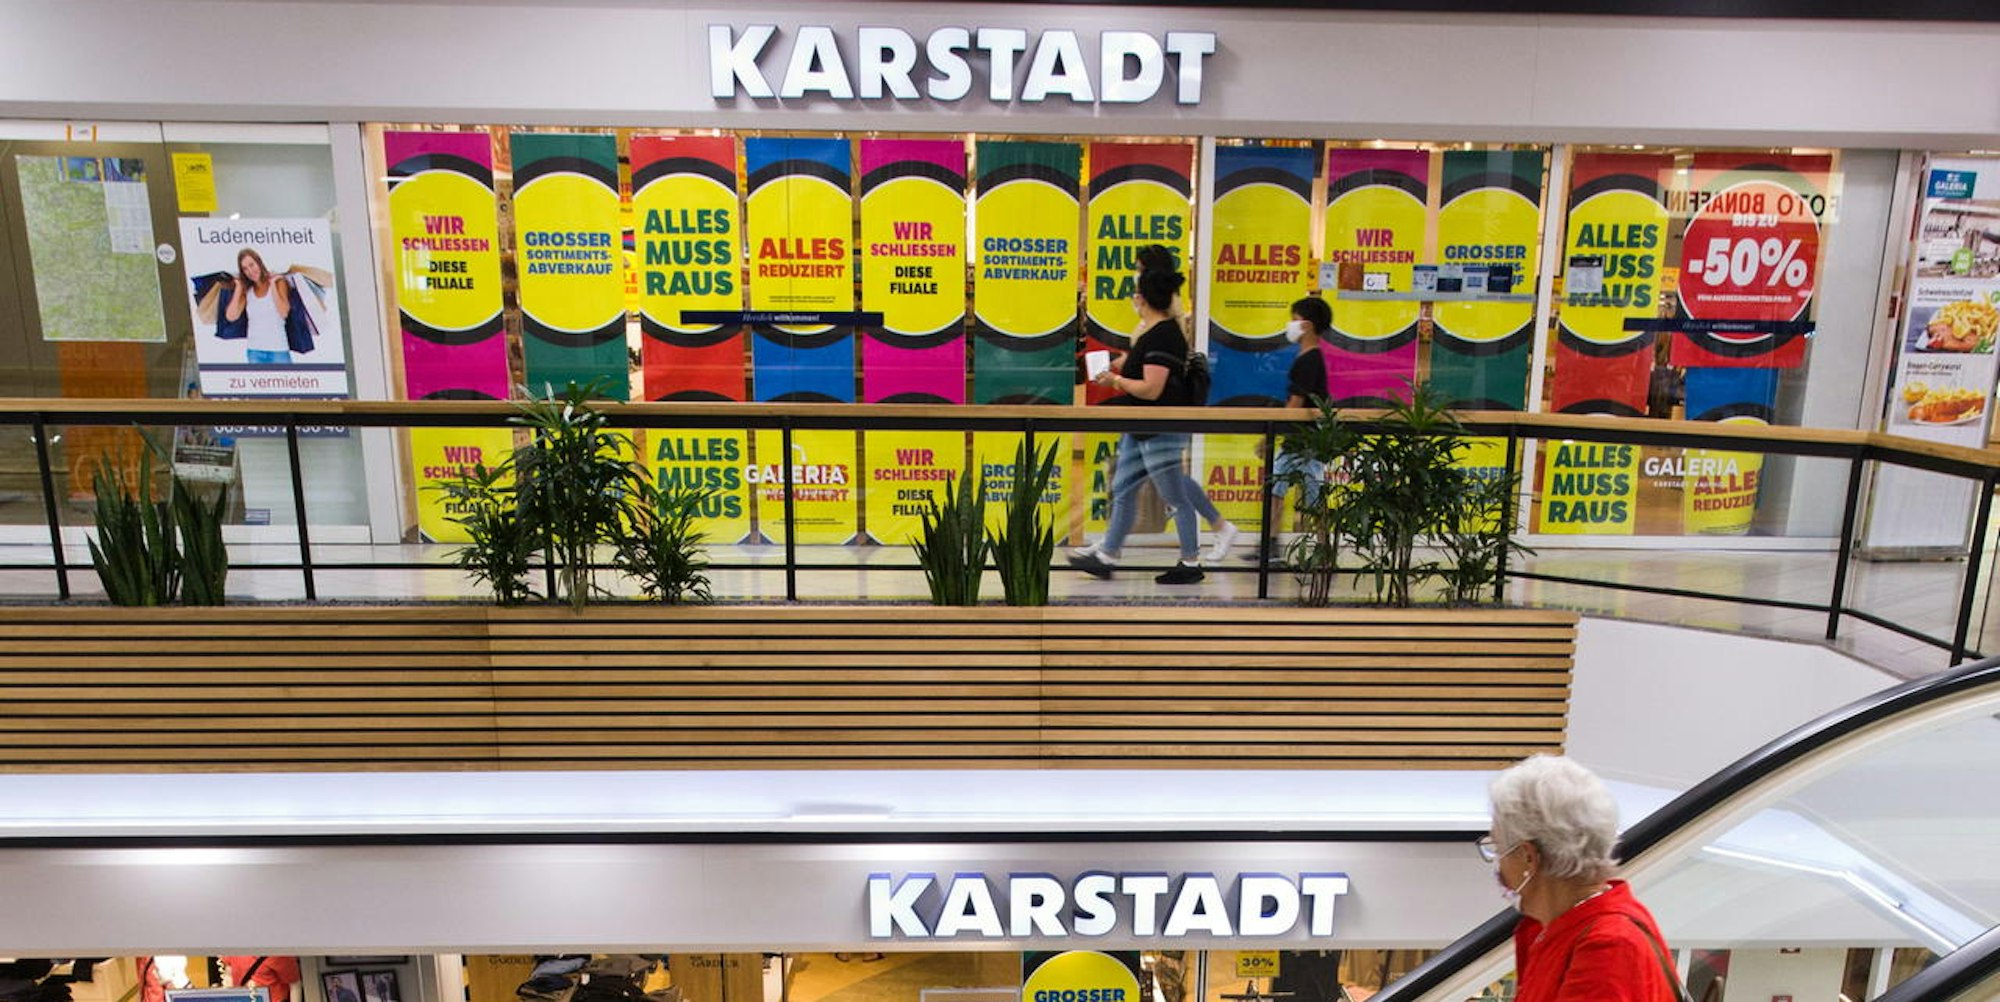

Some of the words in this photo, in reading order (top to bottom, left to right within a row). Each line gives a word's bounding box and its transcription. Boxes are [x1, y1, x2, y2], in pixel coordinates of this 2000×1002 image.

[708, 25, 1216, 104] KARSTADT
[424, 215, 464, 235] WIR
[644, 209, 730, 234] ALLES
[1097, 214, 1183, 240] ALLES
[198, 226, 315, 245] Ladeneinheit
[525, 231, 611, 247] GROSSER
[893, 221, 933, 241] WIR
[1356, 229, 1394, 248] WIR
[1575, 223, 1659, 249] ALLES
[402, 237, 490, 252] SCHLIESSEN
[646, 240, 732, 265] MUSS
[759, 238, 844, 260] ALLES
[870, 244, 956, 258] SCHLIESSEN
[983, 237, 1068, 254] GROSSER
[1445, 245, 1527, 260] GROSSER
[526, 250, 612, 260] SORTIMENTS-
[983, 255, 1068, 267] SORTIMENTS-
[1217, 244, 1301, 266] ALLES
[1332, 250, 1415, 264] SCHLIESSEN
[1687, 238, 1808, 288] -50%
[429, 261, 468, 273] DIESE
[528, 262, 613, 275] ABVERKAUF
[759, 263, 845, 279] REDUZIERT
[895, 266, 933, 279] DIESE
[983, 267, 1068, 282] ABVERKAUF
[426, 277, 474, 290] FILIALE
[646, 271, 733, 296] RAUS
[1216, 270, 1300, 284] REDUZIERT
[890, 281, 938, 295] FILIALE
[229, 377, 246, 389] zu
[250, 375, 320, 390] vermieten
[444, 446, 482, 464] WIR
[657, 438, 740, 461] ALLES
[896, 449, 934, 466] WIR
[1554, 445, 1632, 469] ALLES
[744, 464, 845, 485] GALERIA
[874, 469, 956, 481] SCHLIESSEN
[1644, 457, 1739, 477] GALERIA
[658, 467, 741, 490] MUSS
[1552, 473, 1630, 497] MUSS
[1548, 501, 1628, 524] RAUS
[868, 873, 1350, 938] KARSTADT
[1242, 957, 1274, 968] 30%
[1034, 987, 1126, 1002] GROSSER
